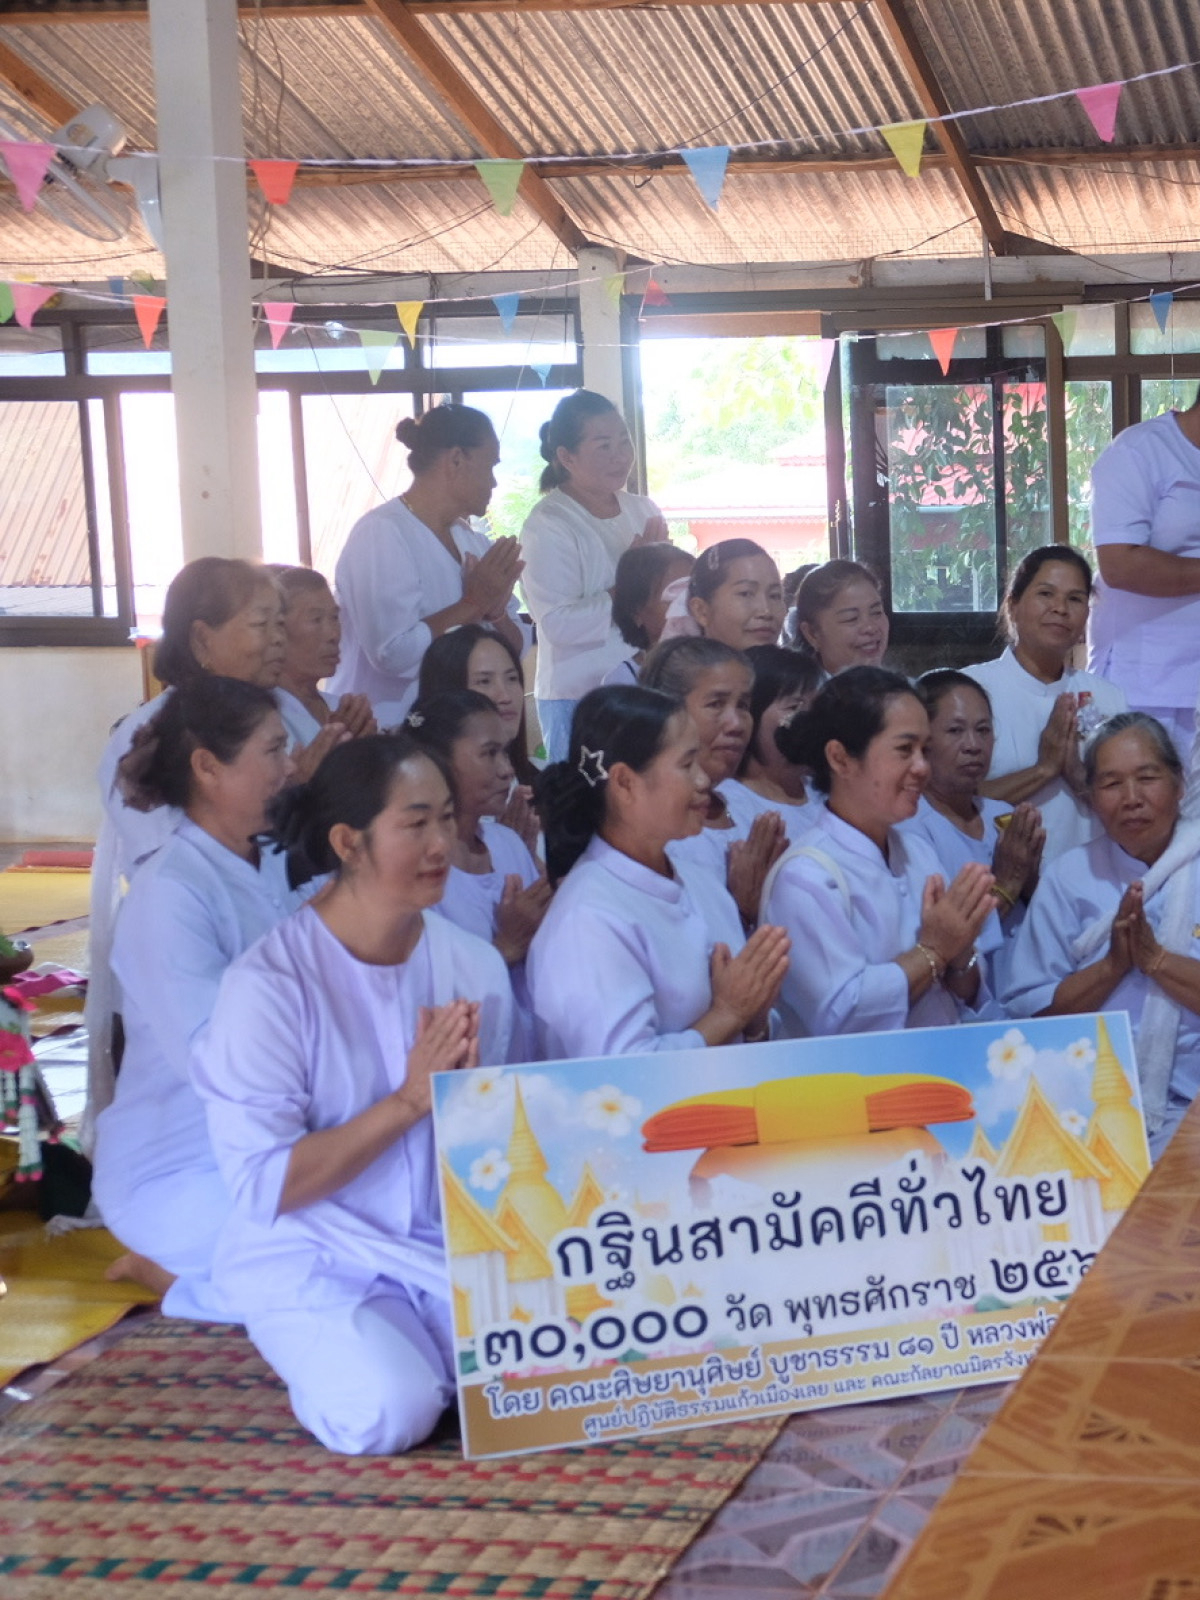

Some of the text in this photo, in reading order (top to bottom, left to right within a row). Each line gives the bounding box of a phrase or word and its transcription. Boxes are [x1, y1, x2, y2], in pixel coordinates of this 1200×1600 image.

[556, 1158, 1067, 1291] กฐินสามัคคีทั่วไทย
[484, 1304, 709, 1366] ๓๐,๐๐๐
[725, 1292, 773, 1332] วัด
[784, 1273, 977, 1338] พุทธศักราช
[485, 1385, 540, 1416] โดย
[549, 1347, 762, 1408] คณะศิษยานุศิษย์
[768, 1340, 890, 1385] บูชาธรรม
[897, 1336, 935, 1357] ๘๑
[940, 1321, 961, 1350] ปี
[833, 1380, 866, 1394] และ
